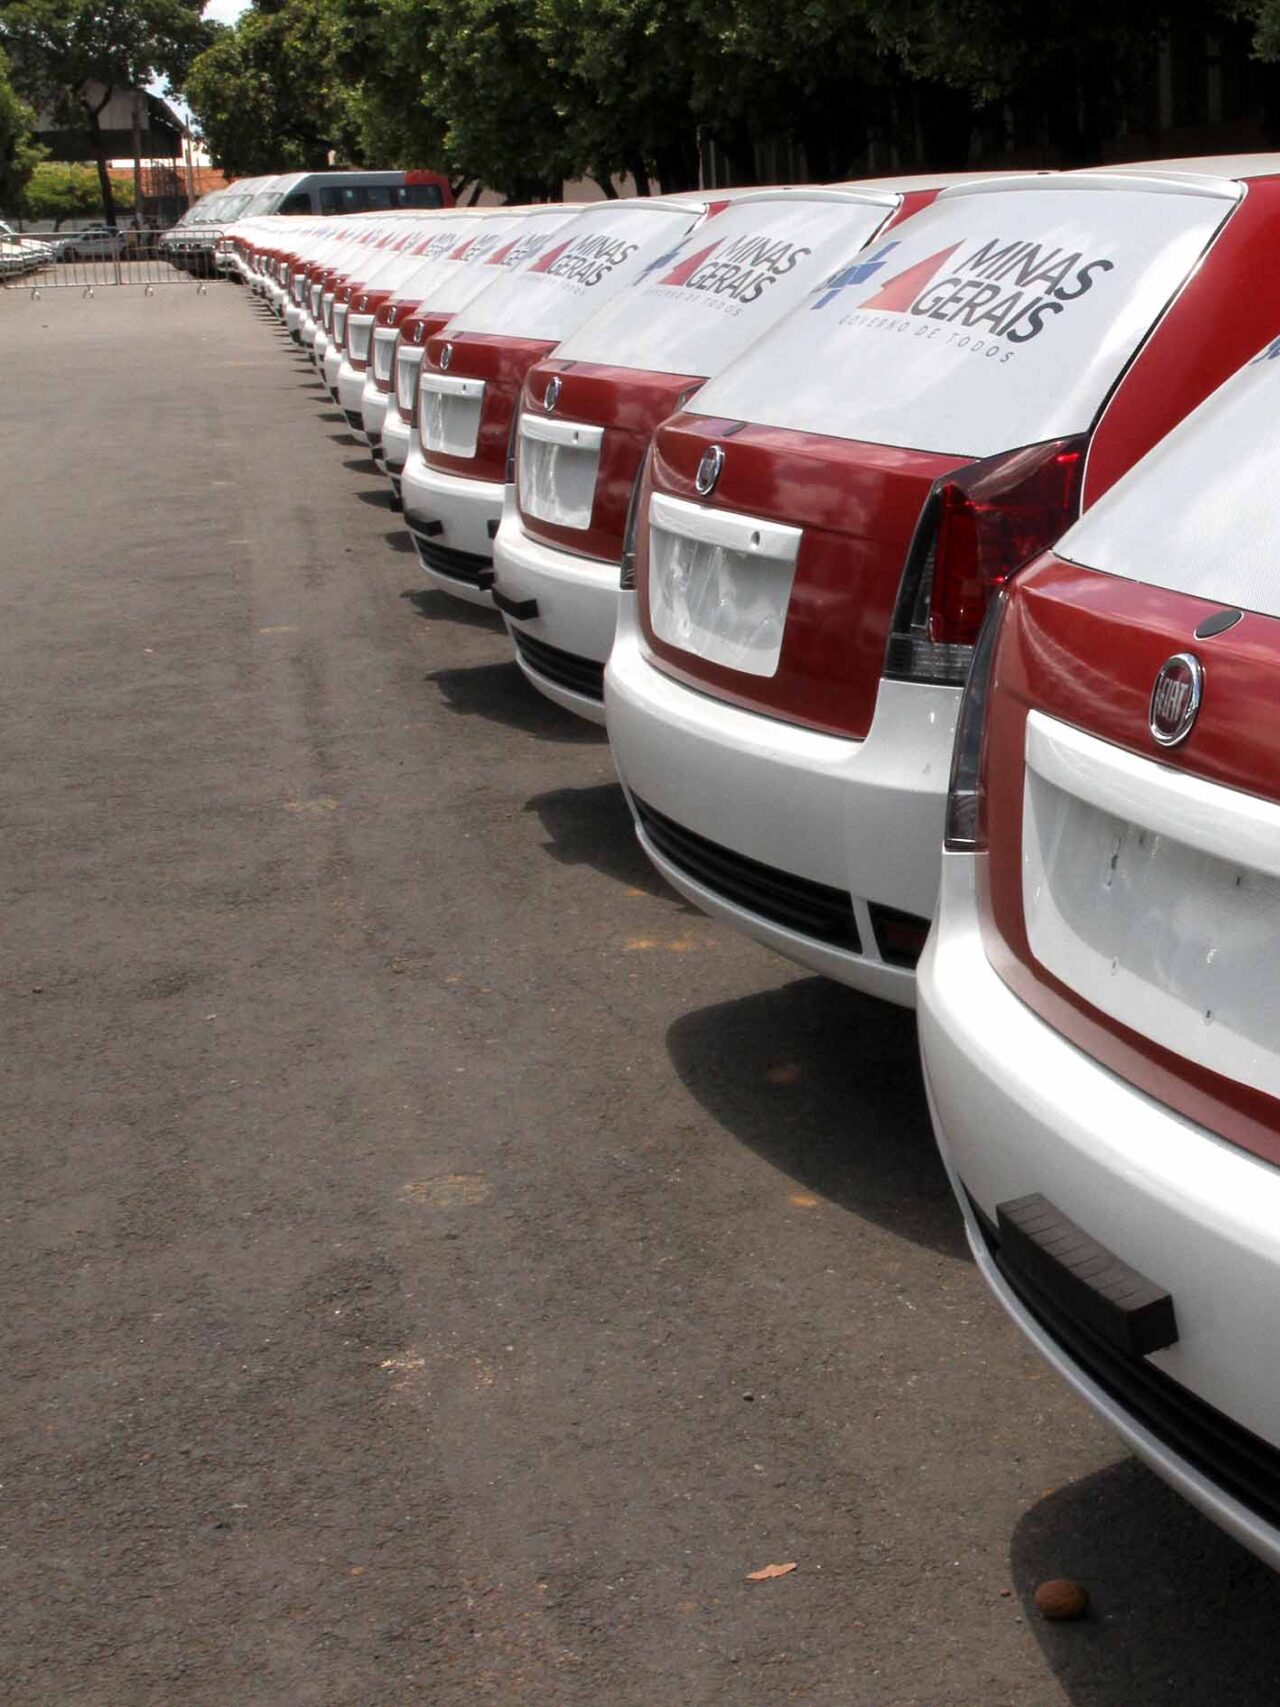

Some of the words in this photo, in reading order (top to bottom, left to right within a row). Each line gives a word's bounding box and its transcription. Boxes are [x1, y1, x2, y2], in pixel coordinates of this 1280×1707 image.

[569, 233, 639, 265] MINAS
[715, 234, 811, 275] MINAS
[952, 238, 1114, 300] MINAS
[686, 261, 777, 303] GERAIS
[910, 277, 1064, 343] GERAIS
[914, 324, 941, 339] DE
[948, 331, 1015, 363] TODOS
[1155, 678, 1189, 720] FIAT
